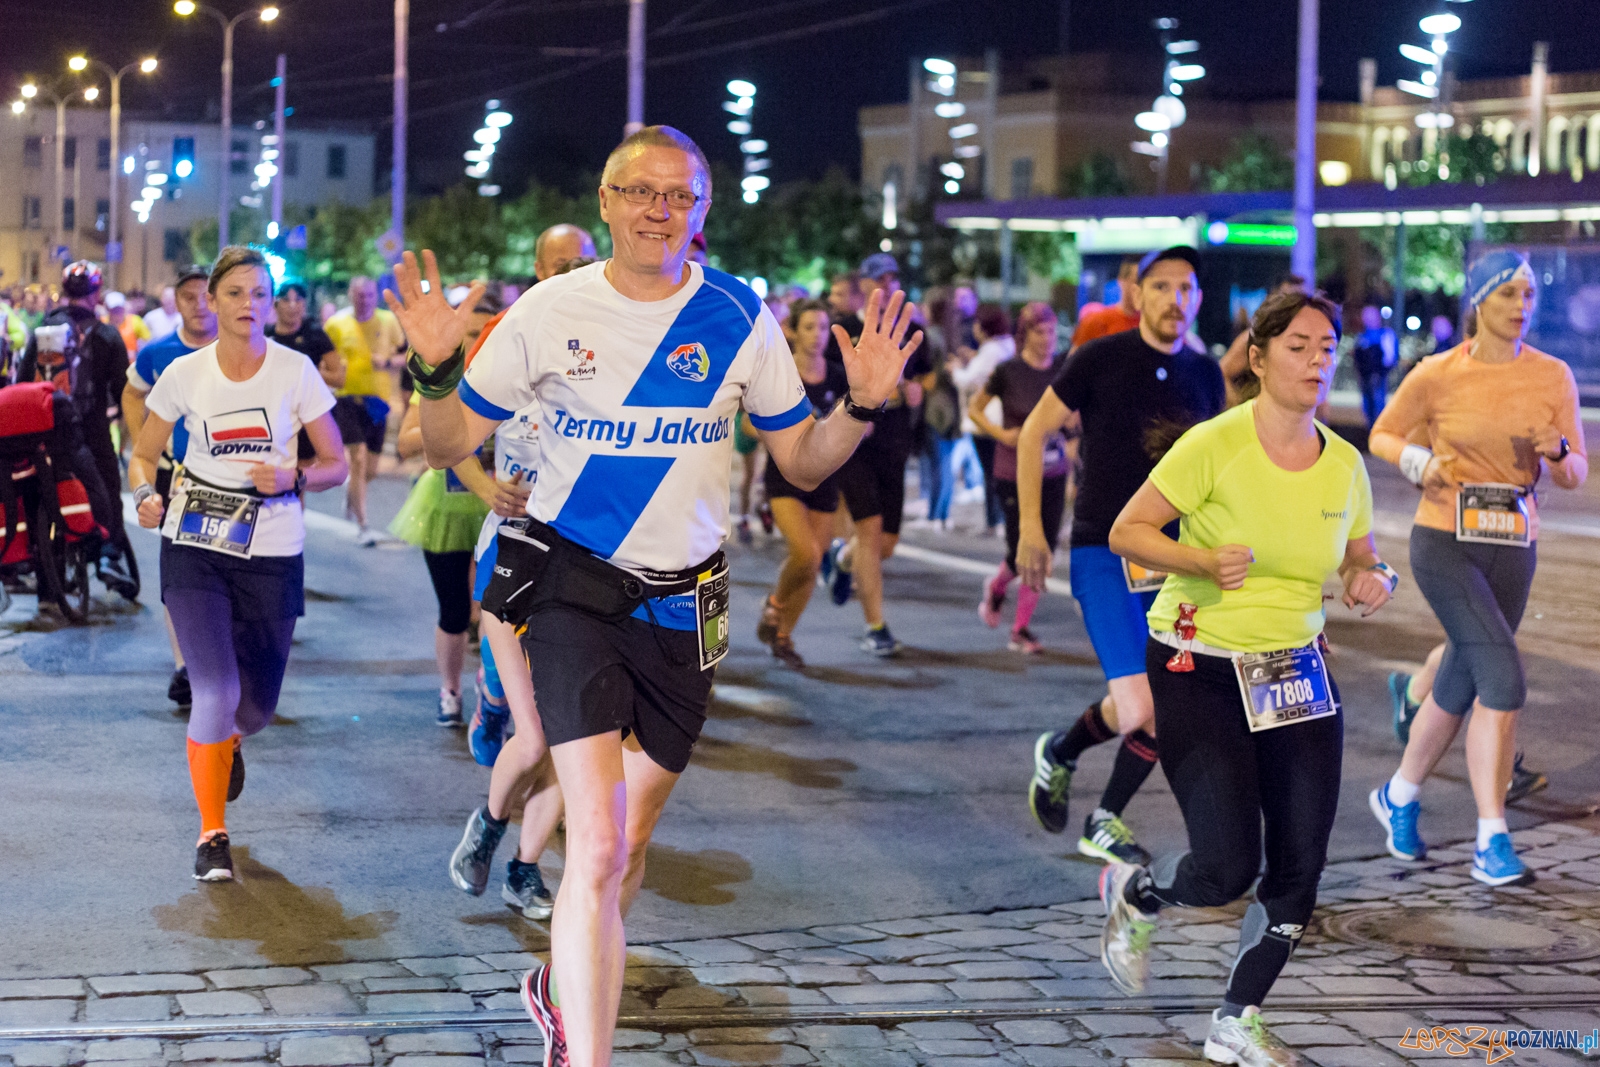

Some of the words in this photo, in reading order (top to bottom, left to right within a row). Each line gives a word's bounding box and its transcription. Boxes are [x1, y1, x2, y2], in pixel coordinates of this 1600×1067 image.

[554, 409, 637, 450] Termy
[643, 415, 729, 445] Jakuba
[210, 443, 272, 456] GDYNIA
[200, 516, 230, 539] 156
[1269, 678, 1314, 708] 7808
